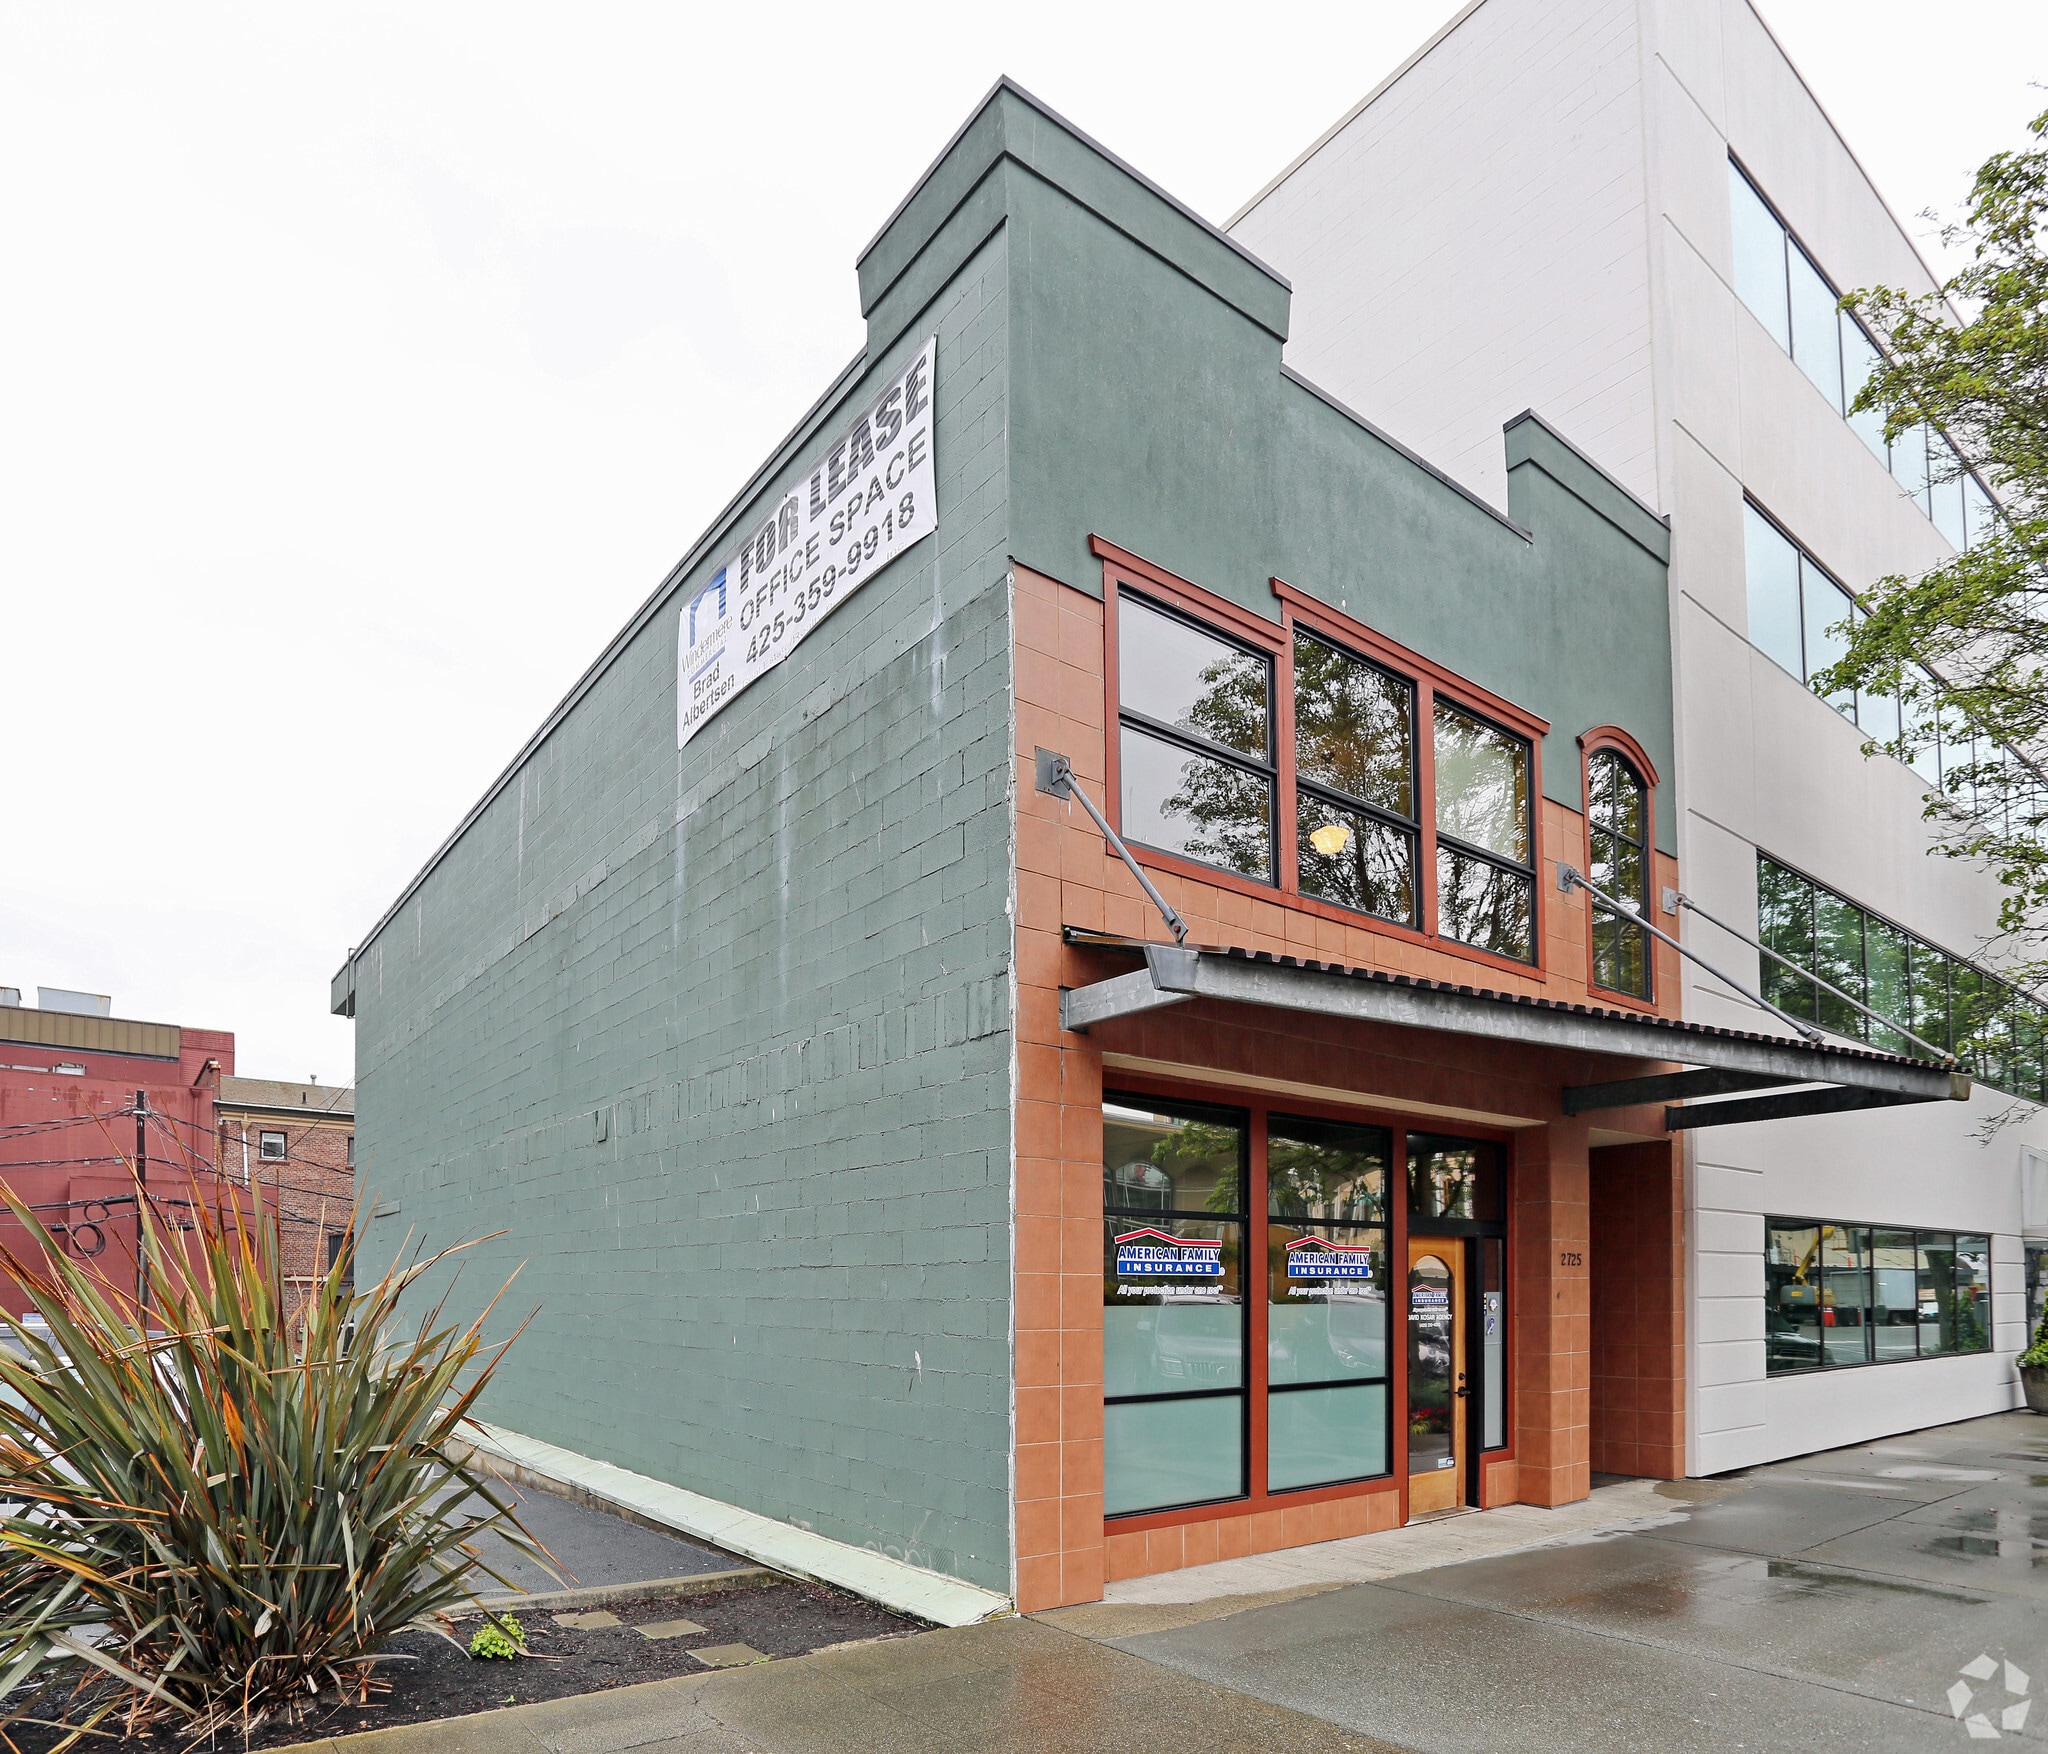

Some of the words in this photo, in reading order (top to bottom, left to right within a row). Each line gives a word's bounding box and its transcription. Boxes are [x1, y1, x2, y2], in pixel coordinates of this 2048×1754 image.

[740, 496, 798, 594] FOR
[810, 354, 928, 523] LEASE
[740, 531, 820, 630] OFFICE
[829, 426, 926, 545] SPACE
[746, 491, 915, 663] 425-359-9918
[682, 616, 732, 672] Windermere
[694, 661, 719, 701] Brad
[683, 674, 734, 731] Albertsen
[1119, 1247, 1178, 1260] AMERICAN
[1182, 1248, 1220, 1260] FAMILY
[1126, 1263, 1213, 1272] INSURANCE
[1290, 1253, 1336, 1264] AMERICAN
[1339, 1254, 1369, 1264] FAMILY
[1295, 1267, 1363, 1275] INSURANCE
[1561, 1252, 1582, 1266] 2725
